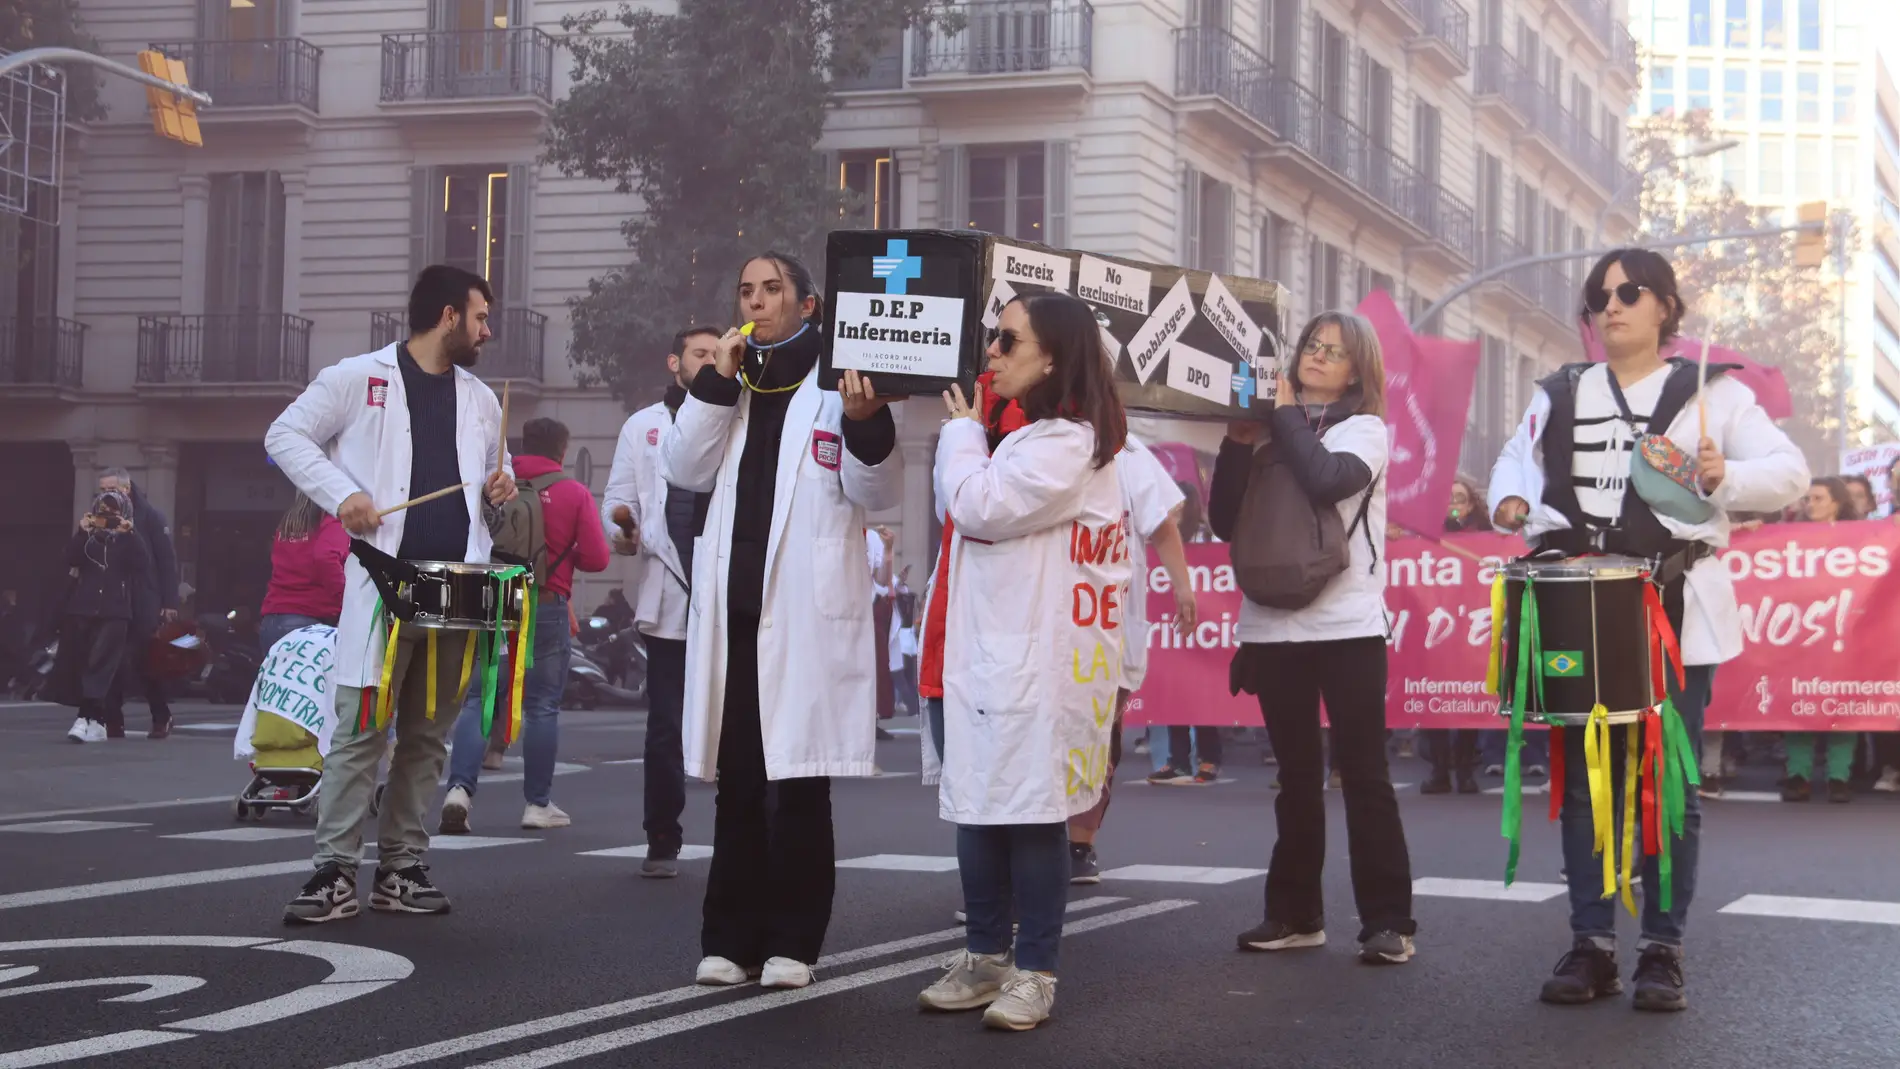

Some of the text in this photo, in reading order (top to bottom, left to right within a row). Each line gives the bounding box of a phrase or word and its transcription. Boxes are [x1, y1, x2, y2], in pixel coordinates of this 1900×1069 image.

[1006, 256, 1054, 282] Escreix
[1105, 267, 1122, 285] No
[869, 299, 924, 319] D.E.P
[1080, 284, 1144, 312] exclusivitat
[1216, 295, 1247, 337] Fuga de
[837, 321, 951, 346] Infermeria
[1137, 303, 1187, 371] Doblatges
[1201, 302, 1253, 365] professionals
[871, 362, 912, 371] SECTORIAL
[874, 353, 900, 361] ACORD
[1187, 367, 1211, 388] DPO
[1719, 540, 1890, 581] ostres
[1404, 697, 1500, 717] de Cataluny
[1791, 699, 1817, 716] de
